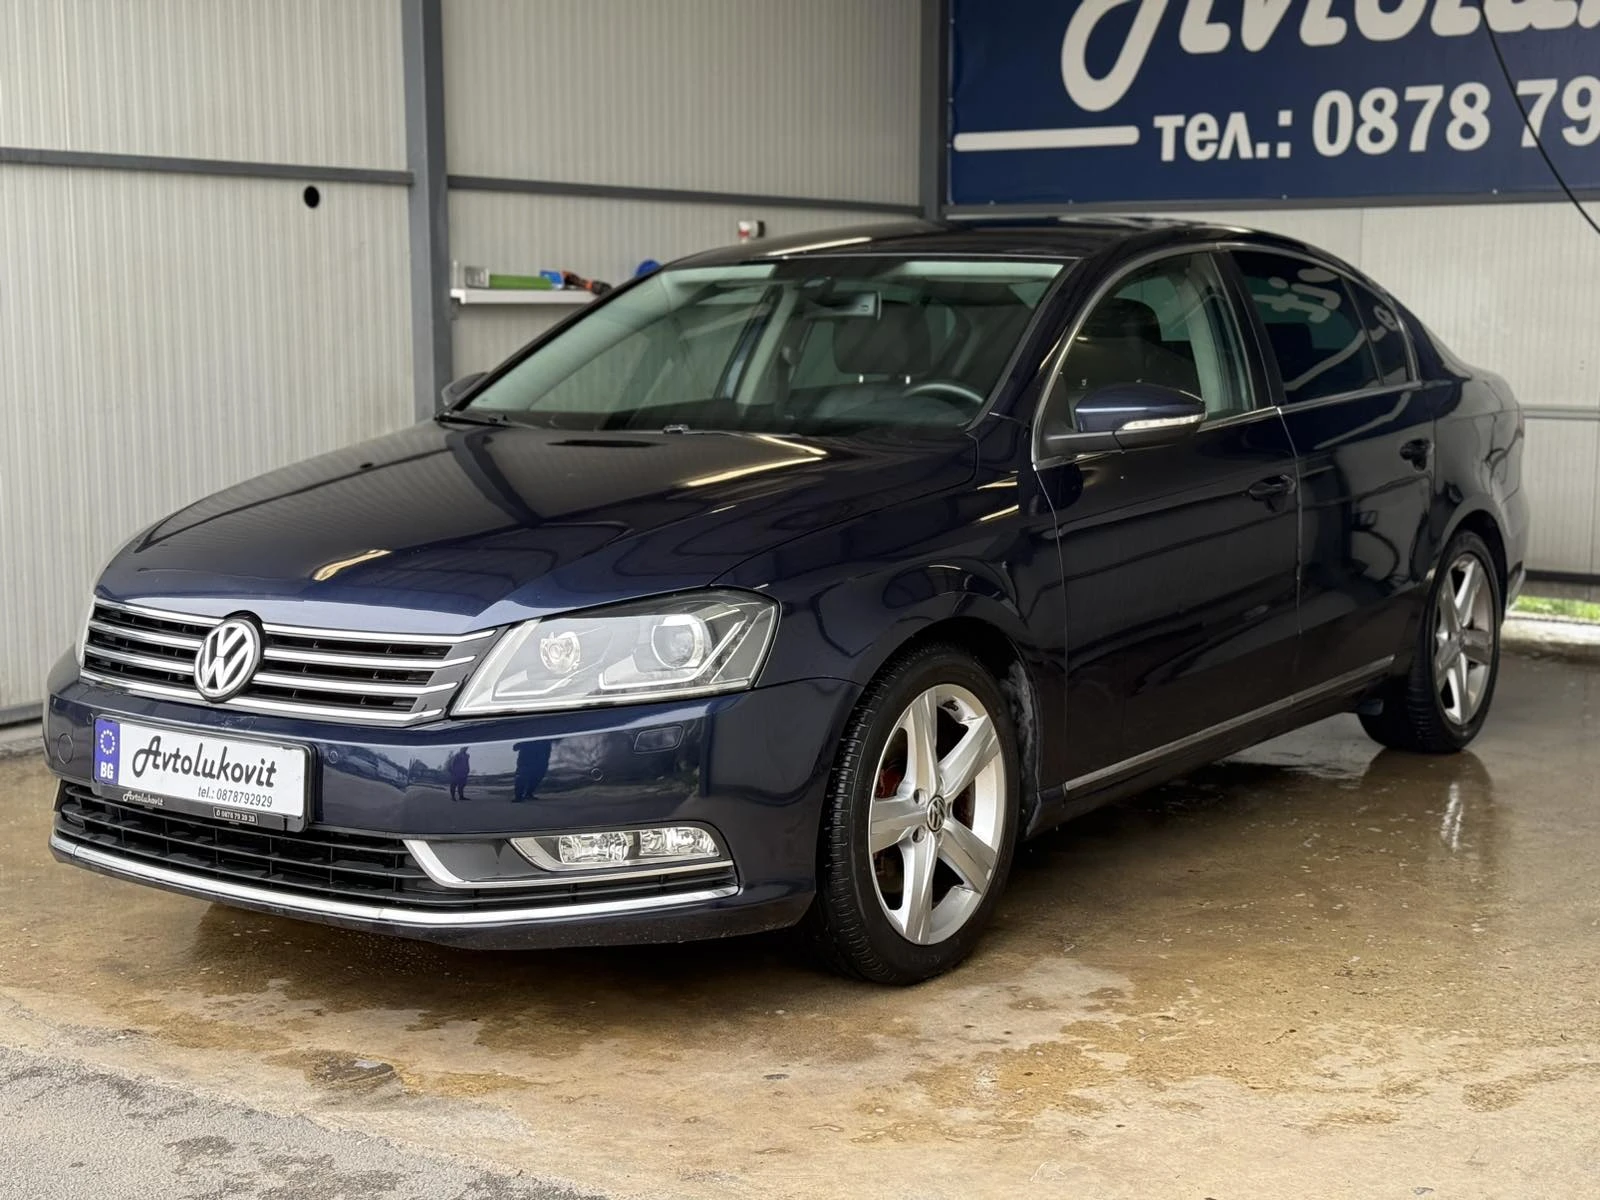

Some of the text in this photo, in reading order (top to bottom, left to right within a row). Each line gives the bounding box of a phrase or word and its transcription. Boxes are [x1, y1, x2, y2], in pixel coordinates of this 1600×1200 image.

[1153, 75, 1600, 162] тел.: 0878 79
[100, 761, 114, 779] BG
[132, 735, 277, 788] Avtolukovit
[198, 786, 273, 808] tel.: 0878792929
